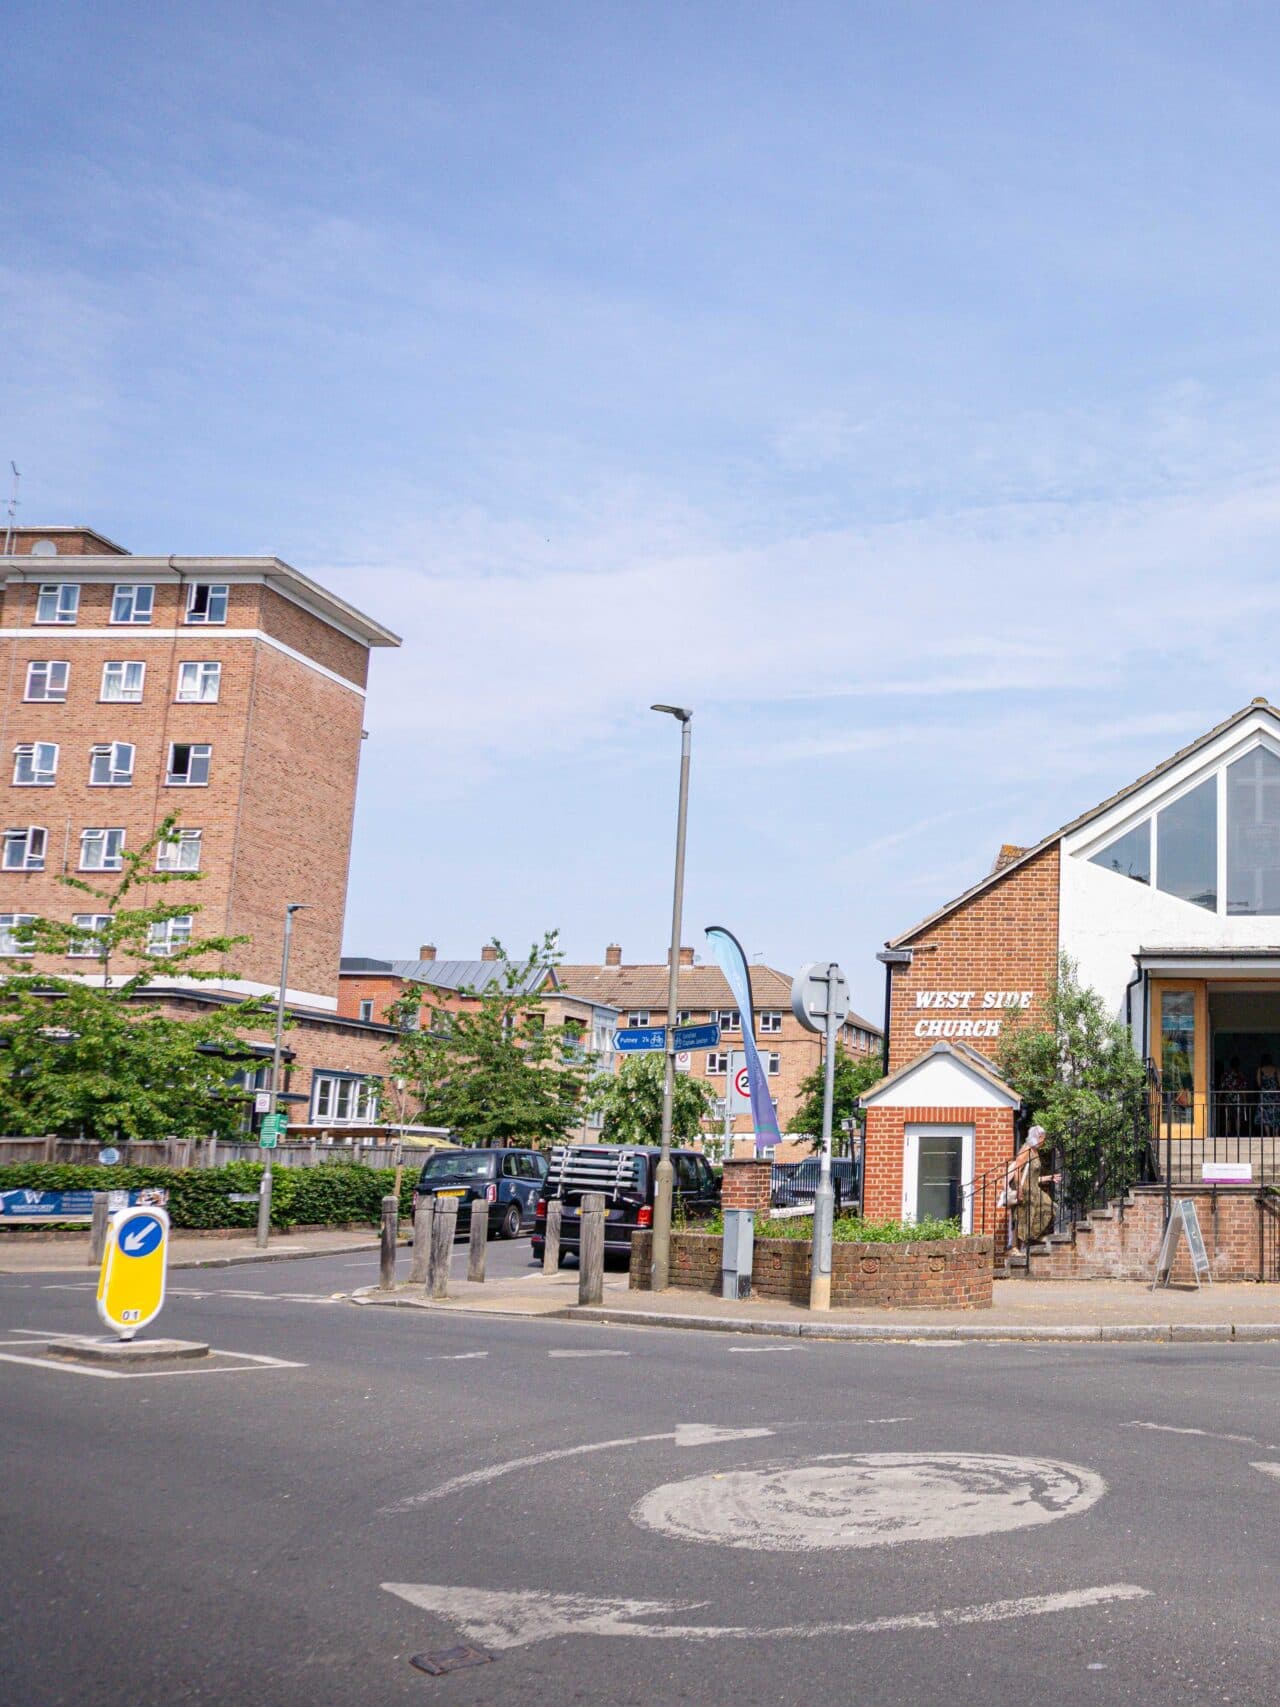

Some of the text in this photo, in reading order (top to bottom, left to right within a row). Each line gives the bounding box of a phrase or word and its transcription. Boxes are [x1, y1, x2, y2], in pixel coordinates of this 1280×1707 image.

[915, 991, 1034, 1009] WEST SIDE
[914, 1020, 1003, 1037] CHURCH
[741, 1076, 749, 1088] 2
